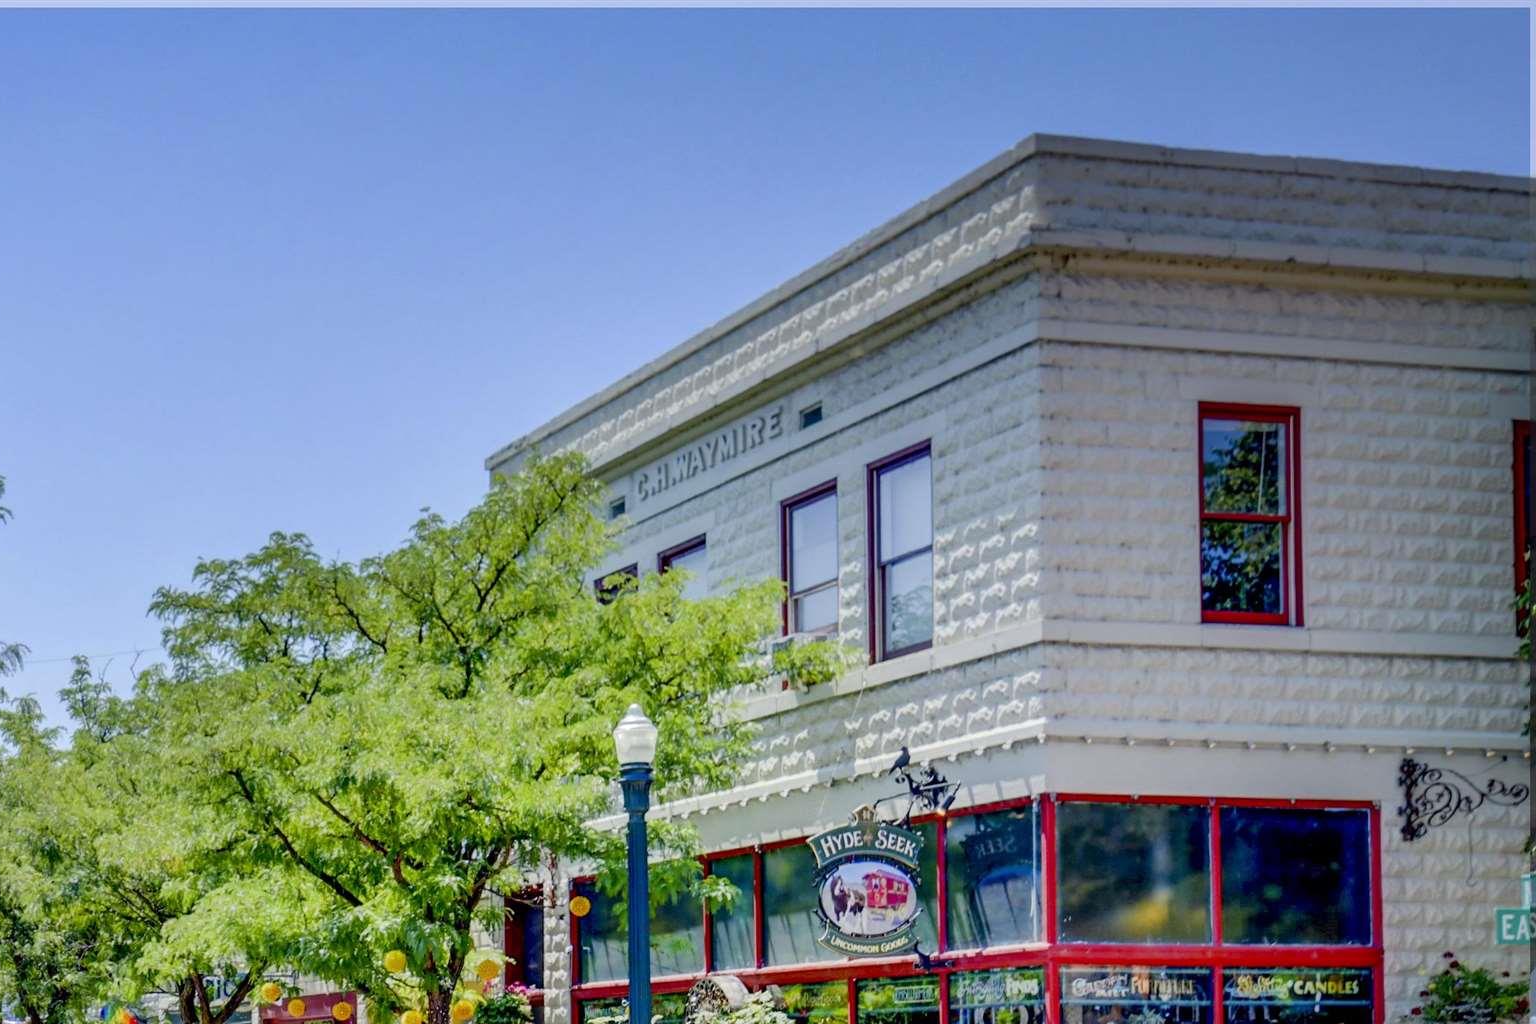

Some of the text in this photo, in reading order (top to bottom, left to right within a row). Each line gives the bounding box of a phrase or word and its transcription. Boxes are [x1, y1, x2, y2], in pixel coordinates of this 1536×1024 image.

[820, 831, 864, 857] HYDE
[875, 829, 916, 857] SEEK
[830, 935, 909, 953] UNCOMMON GOODS
[1294, 979, 1360, 995] CANDLES
